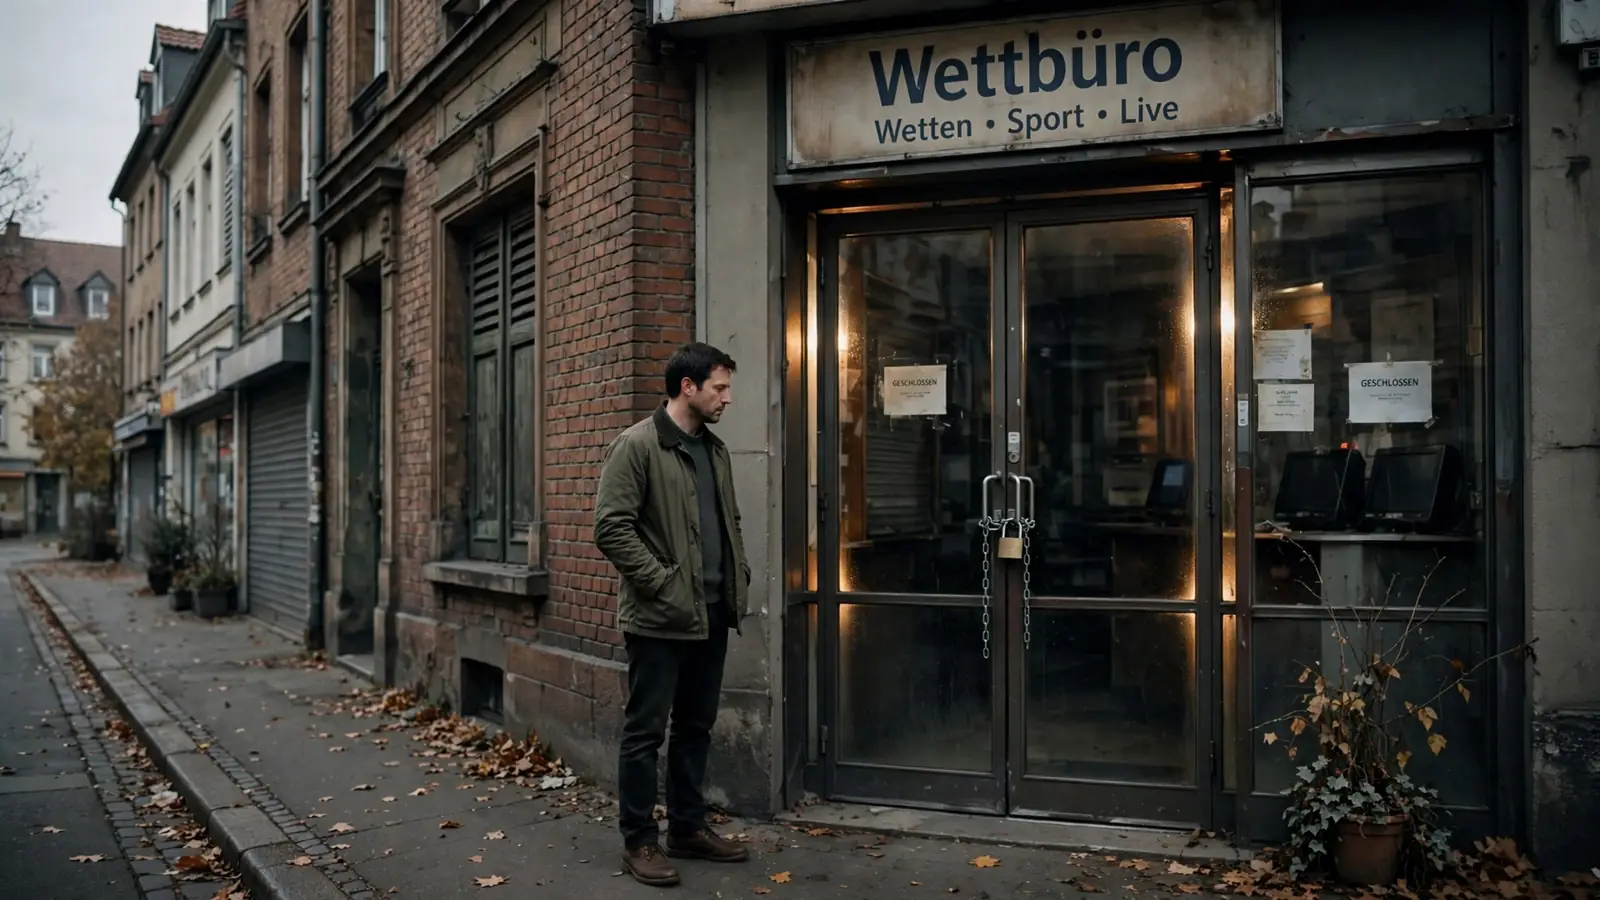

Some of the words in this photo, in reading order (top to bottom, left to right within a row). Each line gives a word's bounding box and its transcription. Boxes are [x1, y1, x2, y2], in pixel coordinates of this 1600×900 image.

[869, 28, 1183, 107] Wettbüro
[874, 116, 972, 145] Wetten
[1007, 104, 1085, 140] Sport
[1120, 97, 1180, 124] Live
[892, 379, 938, 387] GESCHLOSSEN
[1360, 378, 1419, 388] GESCHLOSSEN
